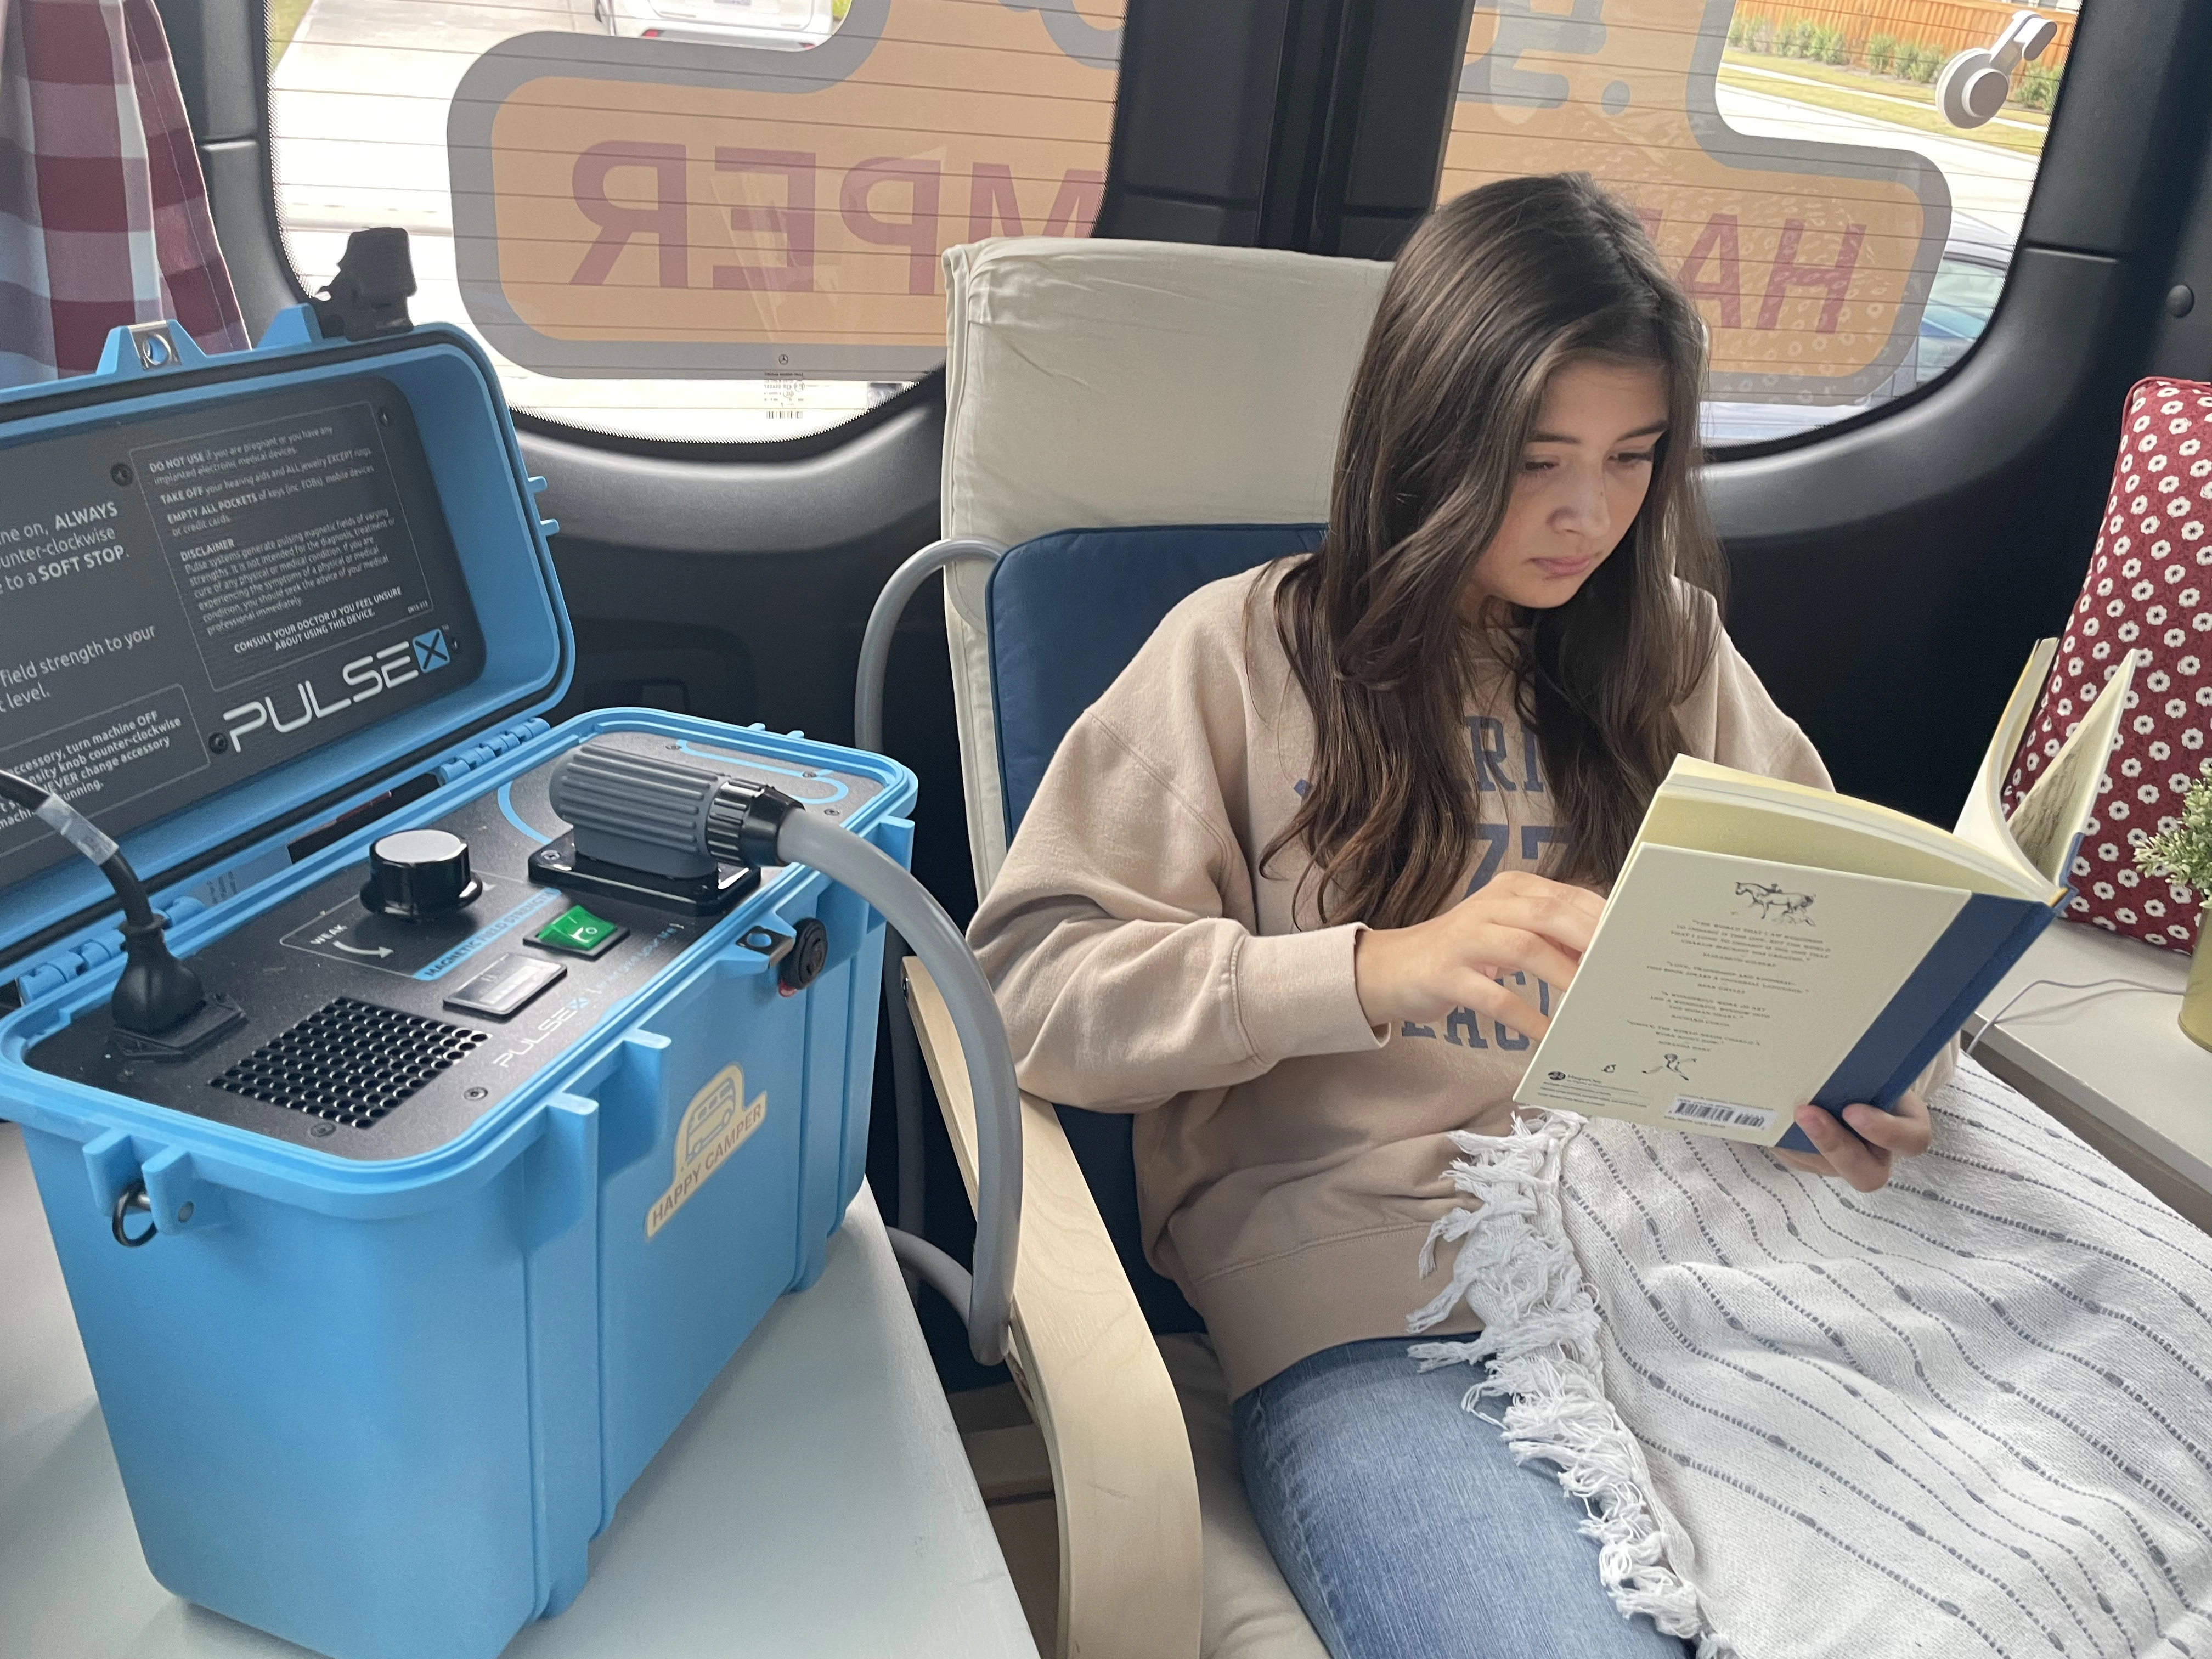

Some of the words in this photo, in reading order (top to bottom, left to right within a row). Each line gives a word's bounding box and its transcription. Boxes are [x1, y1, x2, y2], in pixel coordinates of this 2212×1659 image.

[149, 461, 165, 473] DO
[166, 456, 184, 469] NOT
[187, 452, 204, 464] USE
[160, 490, 185, 504] TAKE
[186, 487, 203, 498] OFF
[286, 464, 300, 473] ALL
[327, 450, 352, 464] EXCEPT
[55, 501, 117, 532] ALWAYS
[167, 508, 198, 524] EMPTY
[202, 504, 218, 515] ALL
[218, 493, 257, 511] POCKETS
[0, 527, 115, 568] unter-clockwise
[5, 576, 24, 590] to
[27, 572, 37, 585] a
[38, 556, 79, 581] SOFT
[83, 545, 129, 568] STOP.
[180, 539, 235, 561] DISCLAIMER
[184, 561, 207, 574] Pulse
[234, 633, 272, 653] CONSULT
[273, 624, 296, 638] YOUR
[297, 612, 330, 630] DOCTOR
[330, 610, 337, 618] IF
[338, 603, 354, 615] YOU
[356, 598, 373, 610] FEEL
[373, 587, 401, 603] UNSURE
[275, 634, 302, 651] ABOUT
[304, 625, 328, 640] USING
[328, 618, 346, 630] THIS
[40, 640, 104, 674] strength
[105, 638, 122, 651] to
[123, 625, 155, 650] your
[58, 754, 87, 774] knob
[89, 718, 182, 761] counter-clockwise
[66, 739, 91, 754] turn
[92, 720, 136, 744] machine
[137, 710, 158, 726] OFF
[81, 757, 119, 779] change
[121, 736, 170, 763] accessory
[653, 1164, 701, 1227] HAPPY
[706, 1104, 762, 1170] CAMPER
